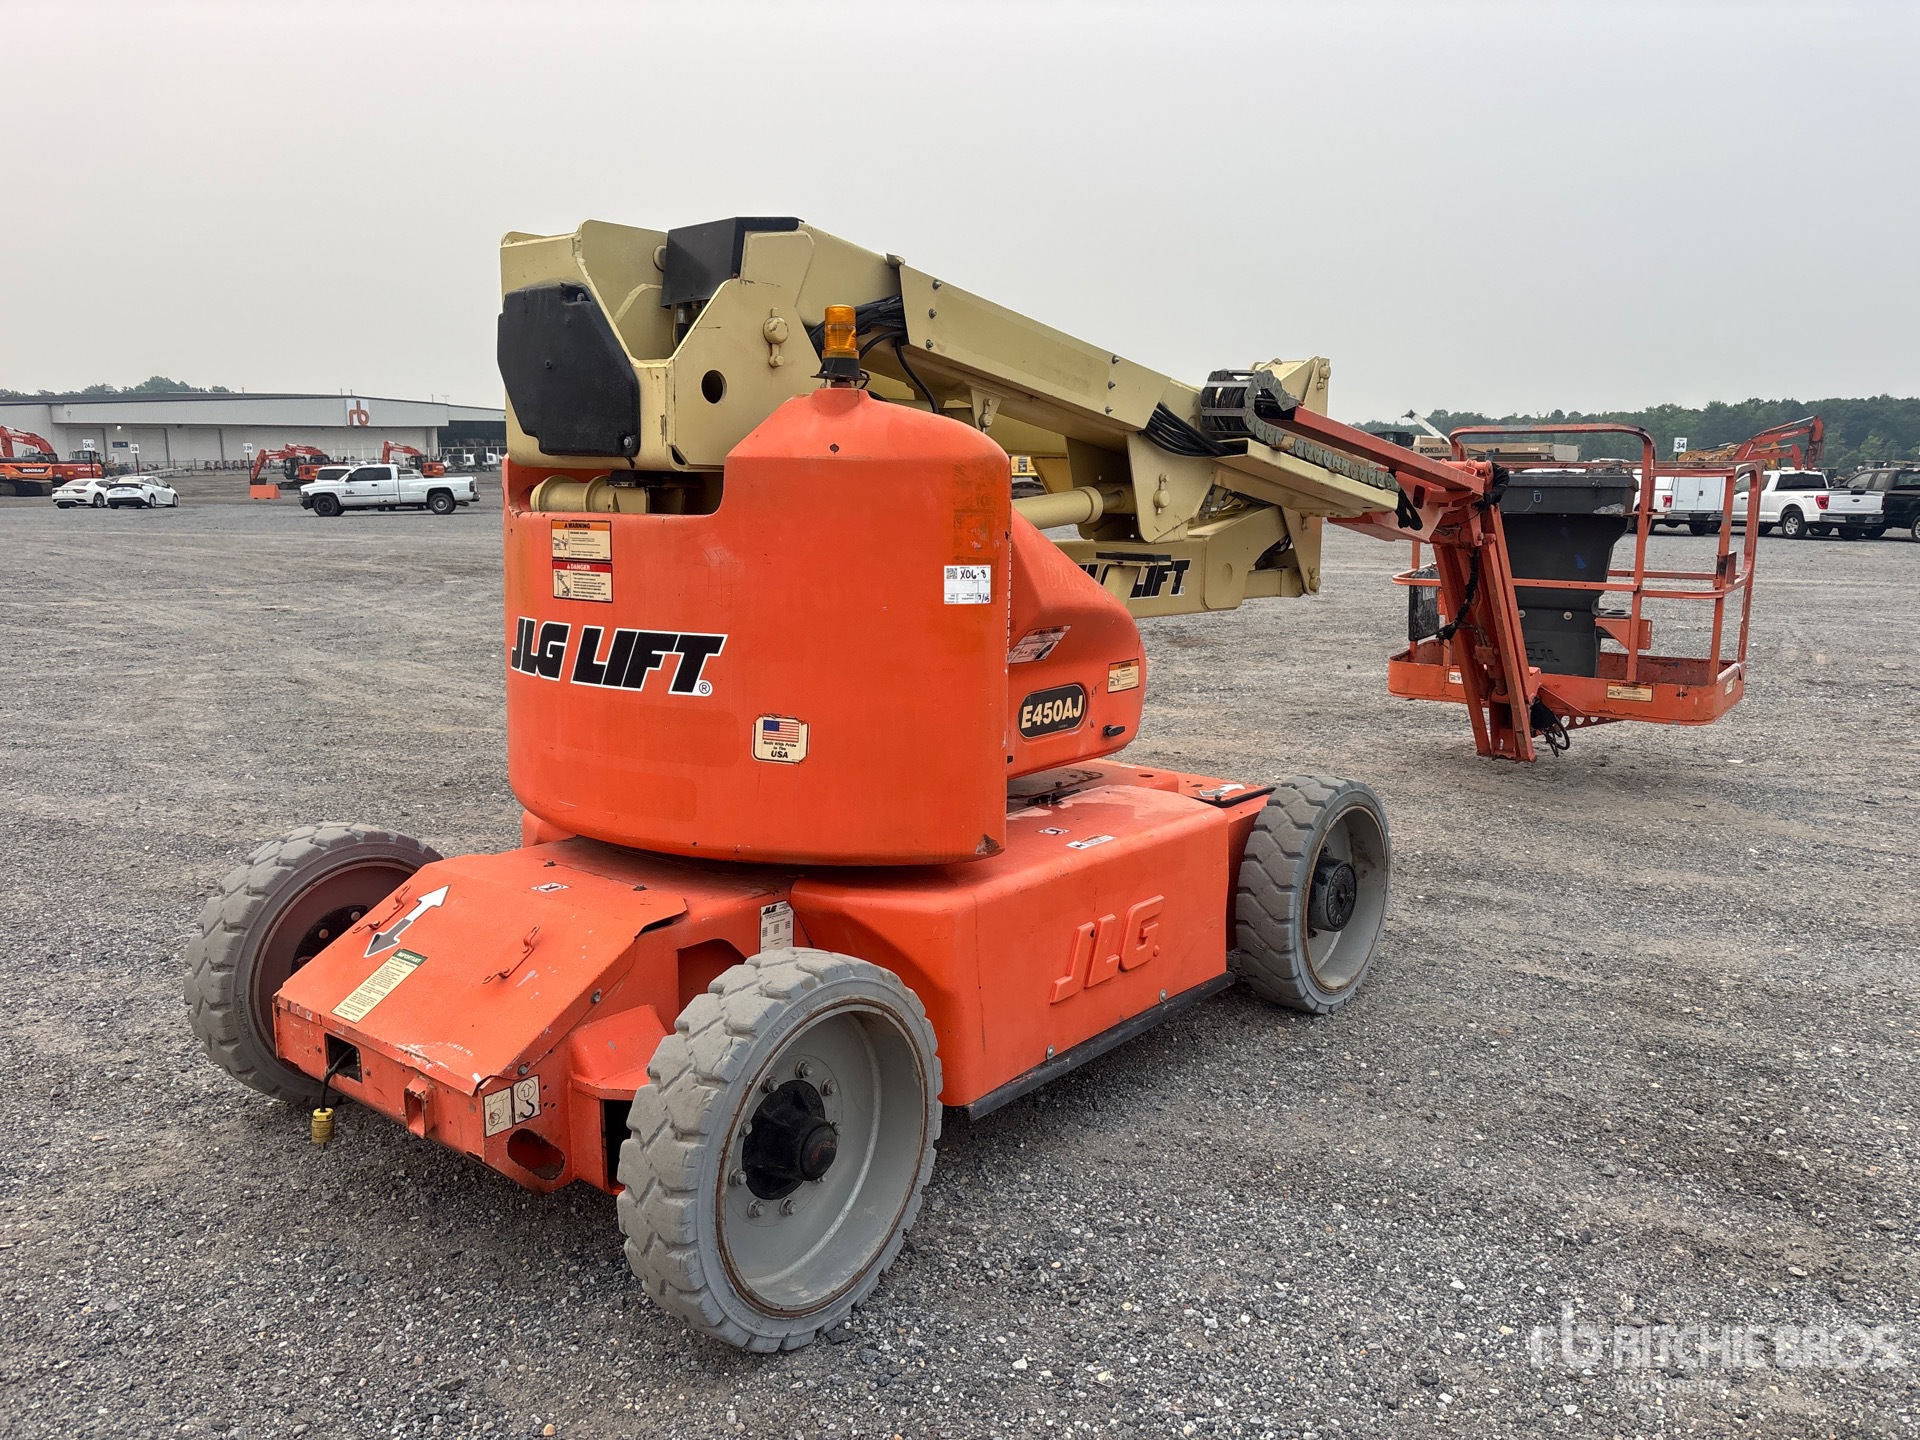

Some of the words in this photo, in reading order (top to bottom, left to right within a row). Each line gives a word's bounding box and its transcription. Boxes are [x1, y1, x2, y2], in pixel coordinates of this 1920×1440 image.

[349, 400, 370, 427] rb
[1419, 446, 1450, 454] ROKBAK
[1676, 441, 1686, 450] 34
[568, 522, 591, 530] WARNING
[570, 563, 591, 571] DANGER
[511, 616, 571, 681] JLG
[570, 625, 728, 696] LIFT
[1021, 694, 1084, 729] E450AJ
[770, 750, 789, 759] USA
[762, 904, 778, 916] JLG
[1049, 894, 1165, 1006] JLG
[396, 951, 422, 964] IMPORTANT
